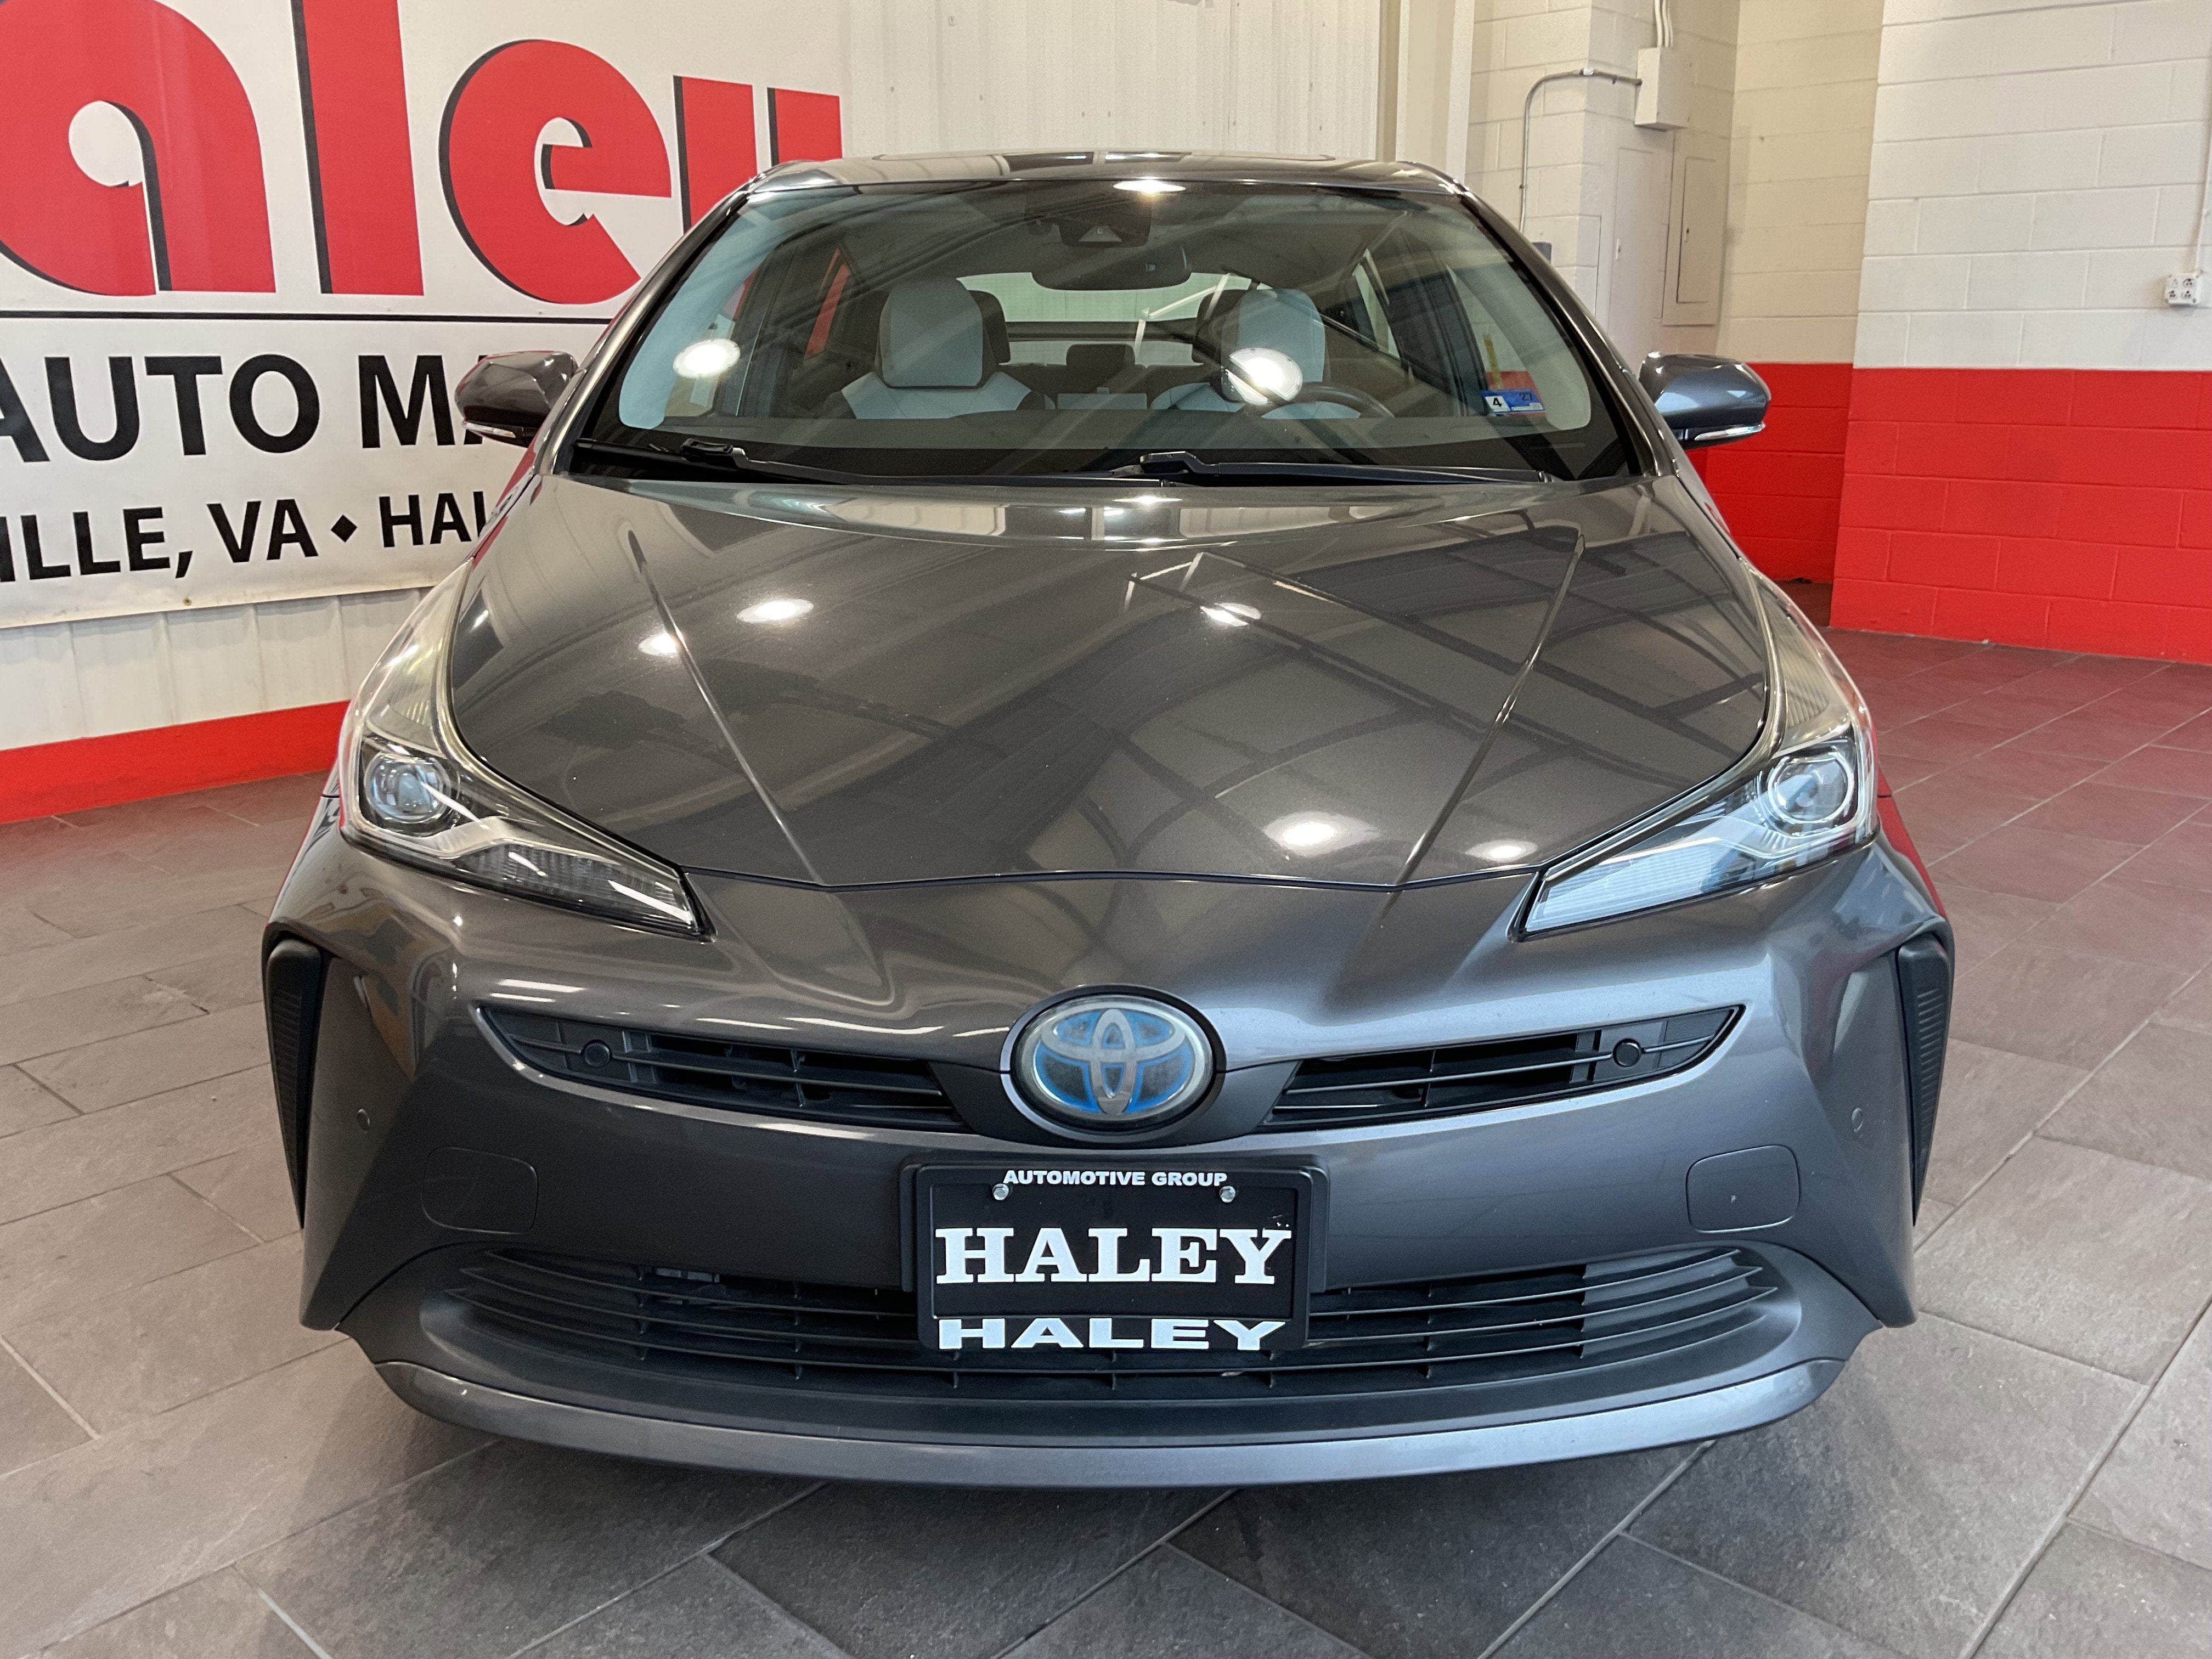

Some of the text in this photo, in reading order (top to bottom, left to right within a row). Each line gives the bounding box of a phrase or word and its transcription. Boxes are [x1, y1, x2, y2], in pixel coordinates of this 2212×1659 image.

[1493, 397, 1502, 407] 4
[207, 499, 318, 563] VA
[1003, 1170, 1227, 1187] AUTOMOTIVE GROUP
[935, 1227, 1292, 1284] HALEY
[939, 1317, 1286, 1351] HALEY
